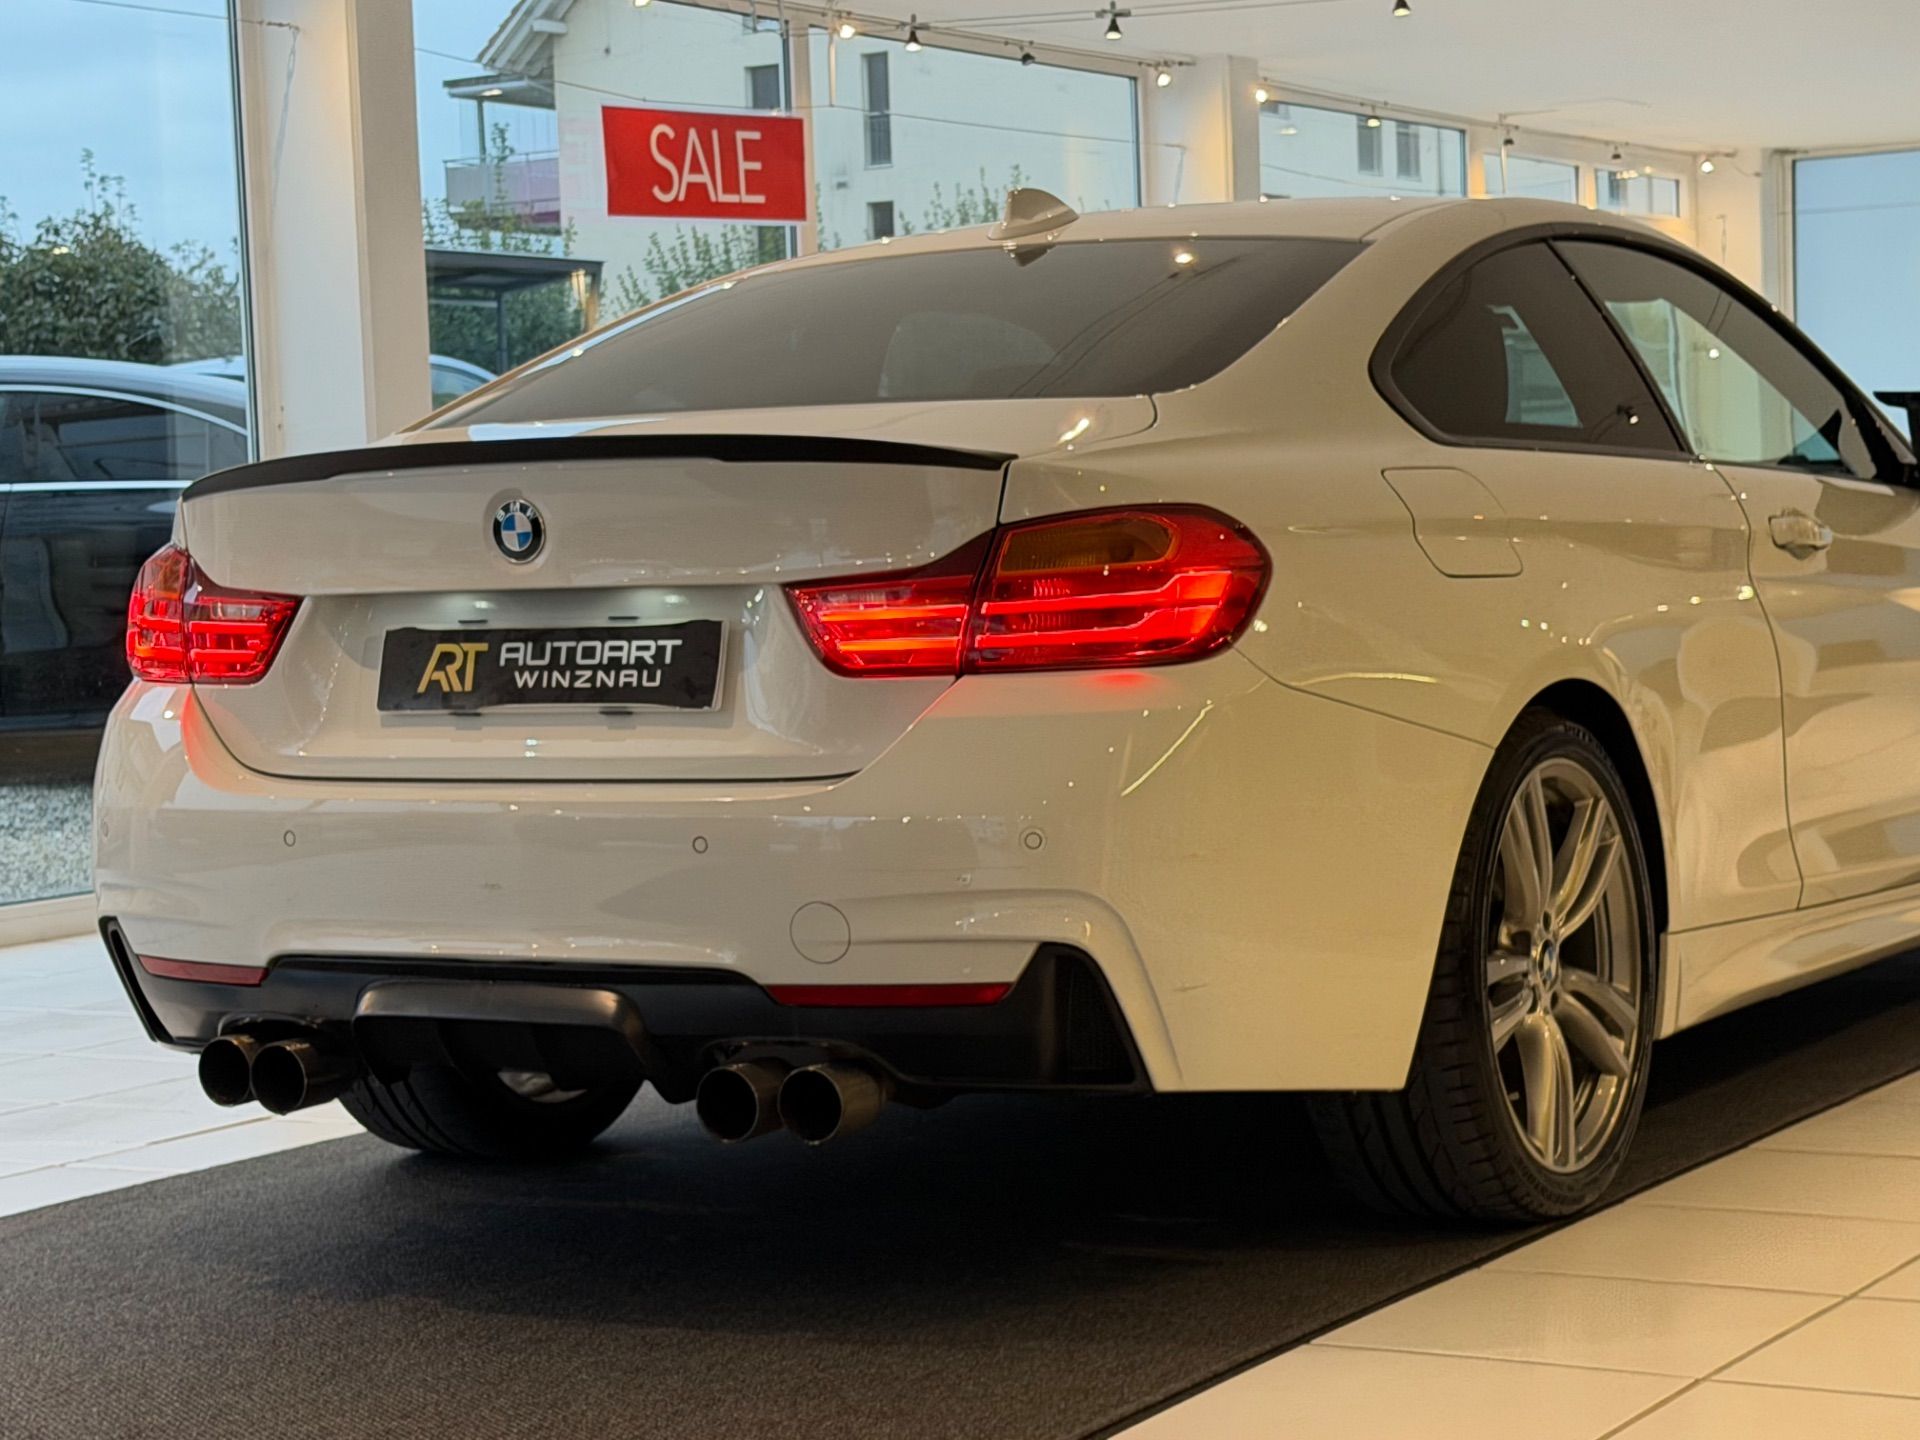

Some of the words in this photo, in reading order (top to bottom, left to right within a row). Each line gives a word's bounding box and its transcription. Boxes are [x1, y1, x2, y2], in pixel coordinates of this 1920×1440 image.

[650, 123, 766, 203] SALE
[499, 639, 683, 667] AUTOART
[514, 669, 662, 689] WINZNAU
